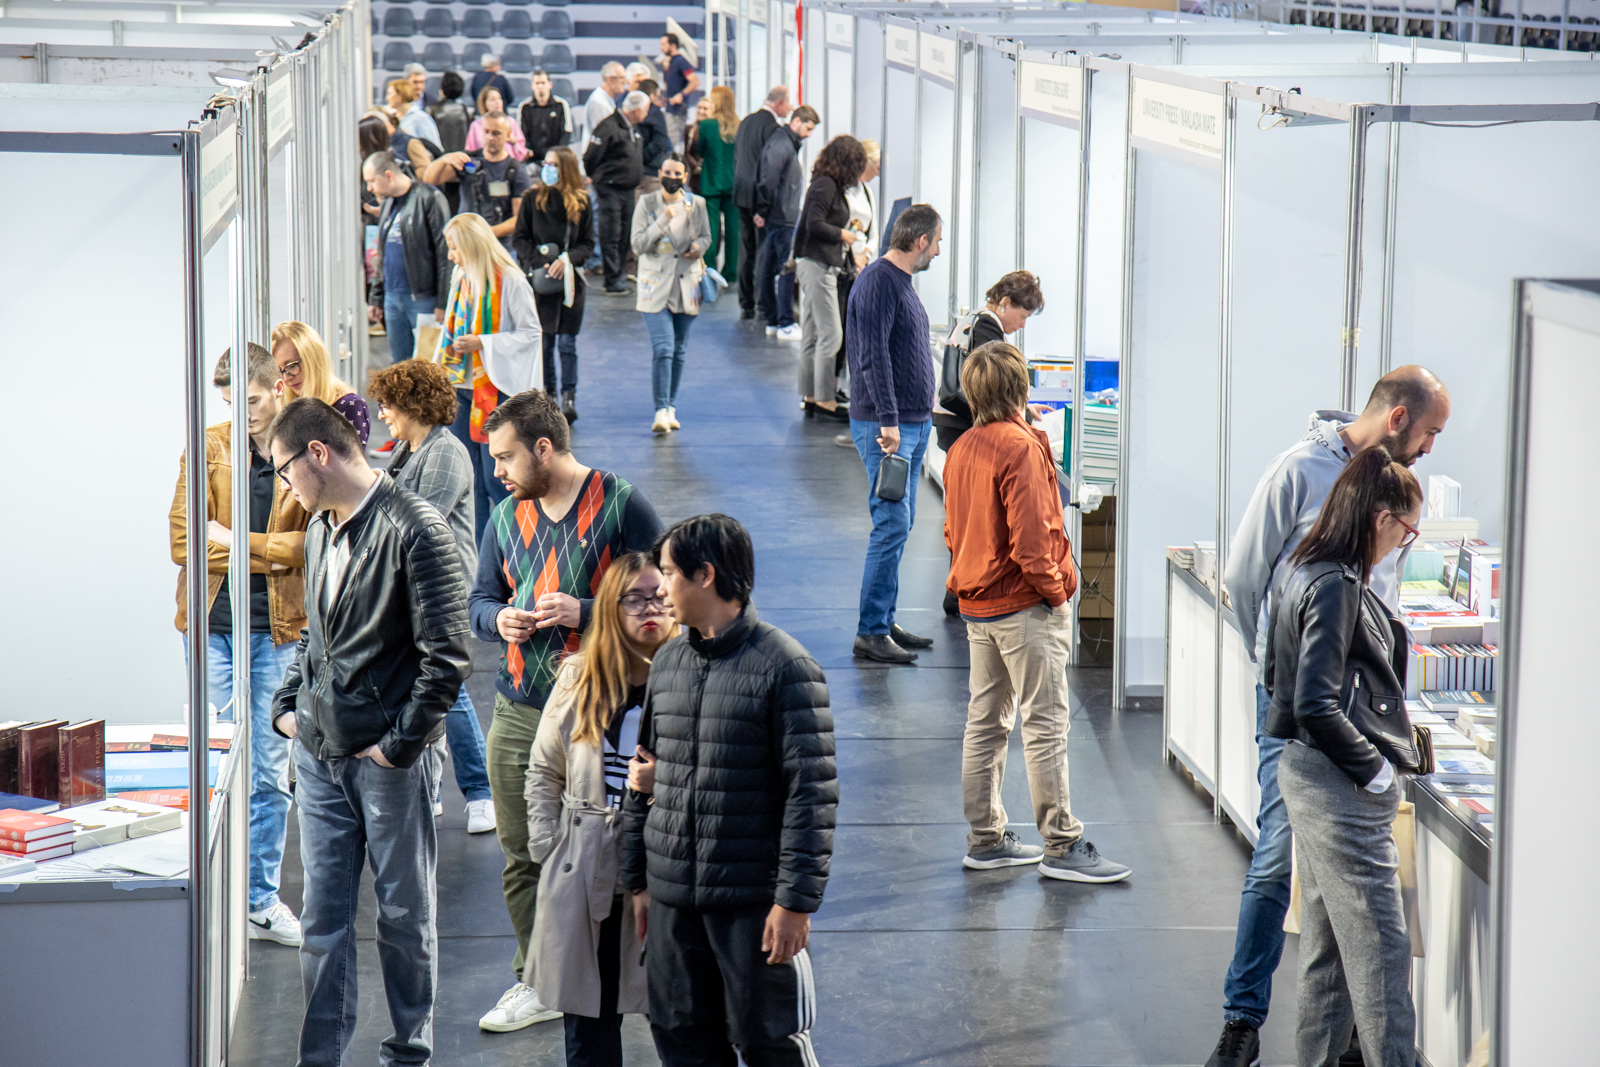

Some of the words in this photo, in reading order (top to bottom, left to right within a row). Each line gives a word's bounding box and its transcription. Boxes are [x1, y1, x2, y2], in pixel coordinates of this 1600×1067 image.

[1142, 97, 1164, 121] UNIVERSITY
[1165, 103, 1178, 125] PRESS
[1181, 108, 1202, 132] NAKLADA
[1202, 113, 1216, 136] MATE
